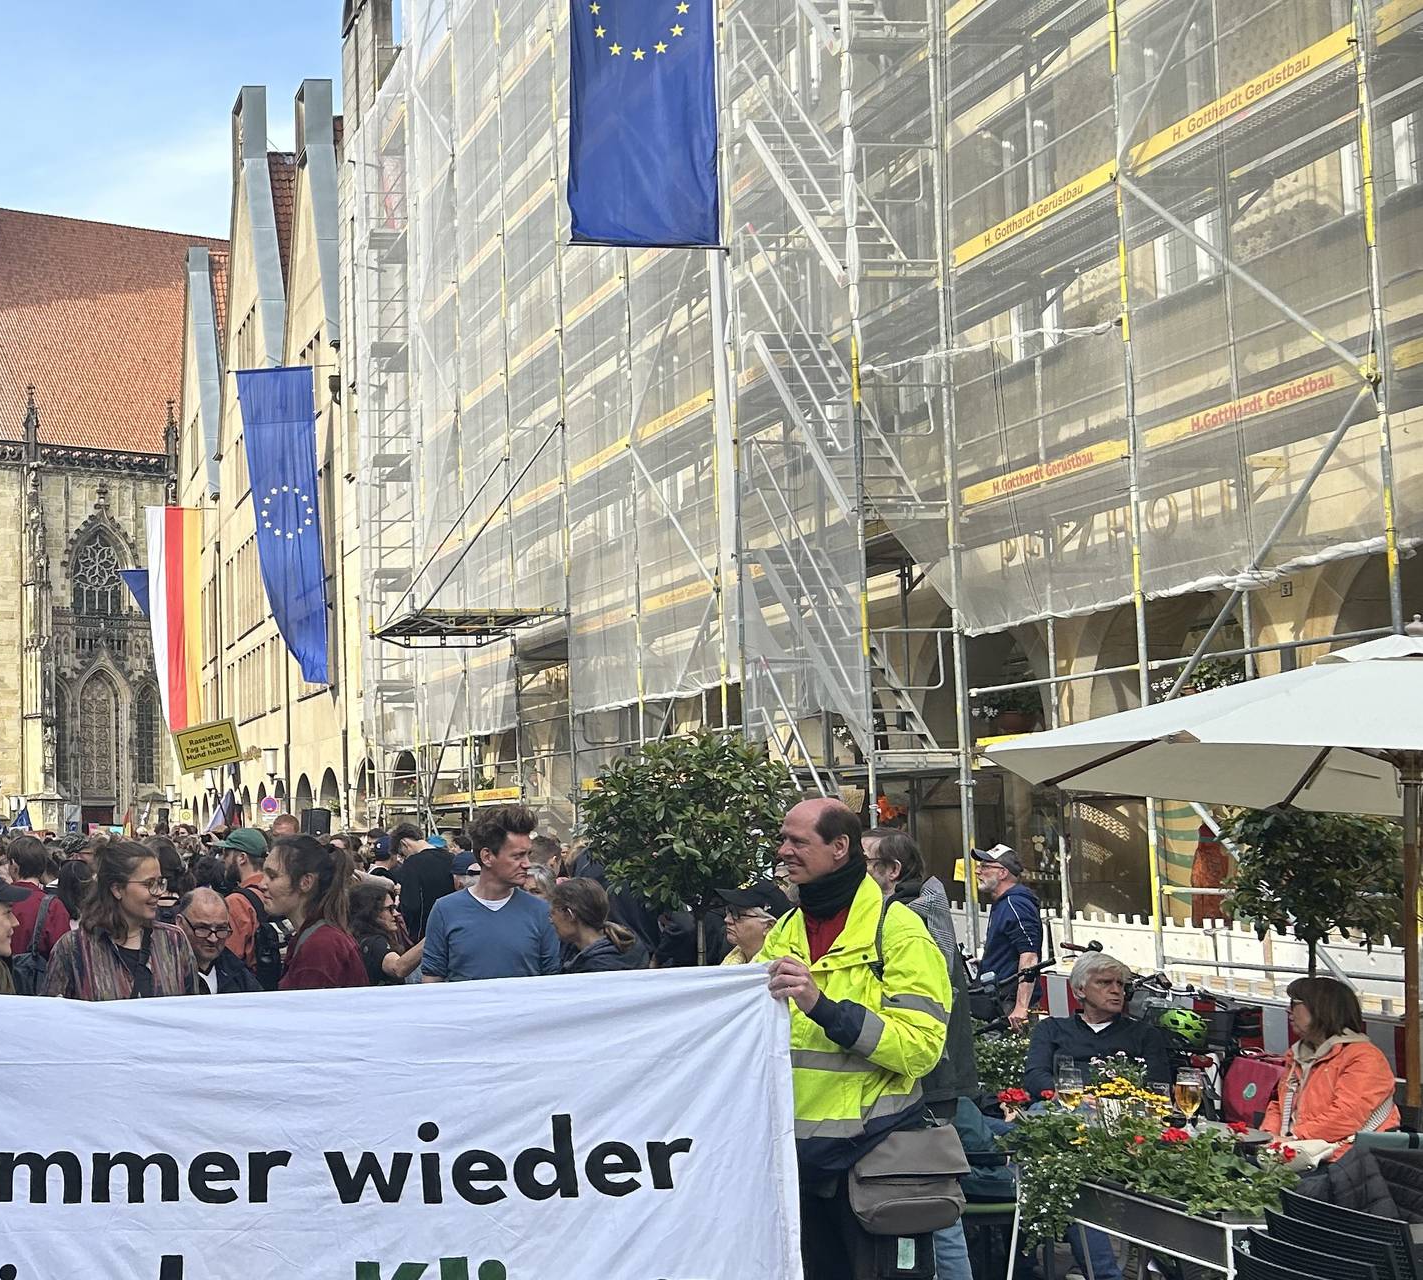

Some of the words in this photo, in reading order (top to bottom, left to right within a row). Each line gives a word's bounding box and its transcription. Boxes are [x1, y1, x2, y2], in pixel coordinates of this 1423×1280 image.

[1172, 125, 1184, 142] H.
[1186, 94, 1243, 134] Gotthardt
[1244, 54, 1312, 101] Gerüstbau
[994, 209, 1036, 240] Gotthardt
[1036, 182, 1085, 219] Gerüstbau
[1266, 372, 1335, 408] Gerüstbau
[1045, 450, 1095, 480] Gerüstbau
[185, 746, 199, 755] Tag
[209, 738, 231, 749] Nacht
[186, 751, 206, 761] Mund
[208, 745, 233, 755] halten!
[189, 733, 223, 745] Rassisten
[323, 1113, 692, 1205] wieder
